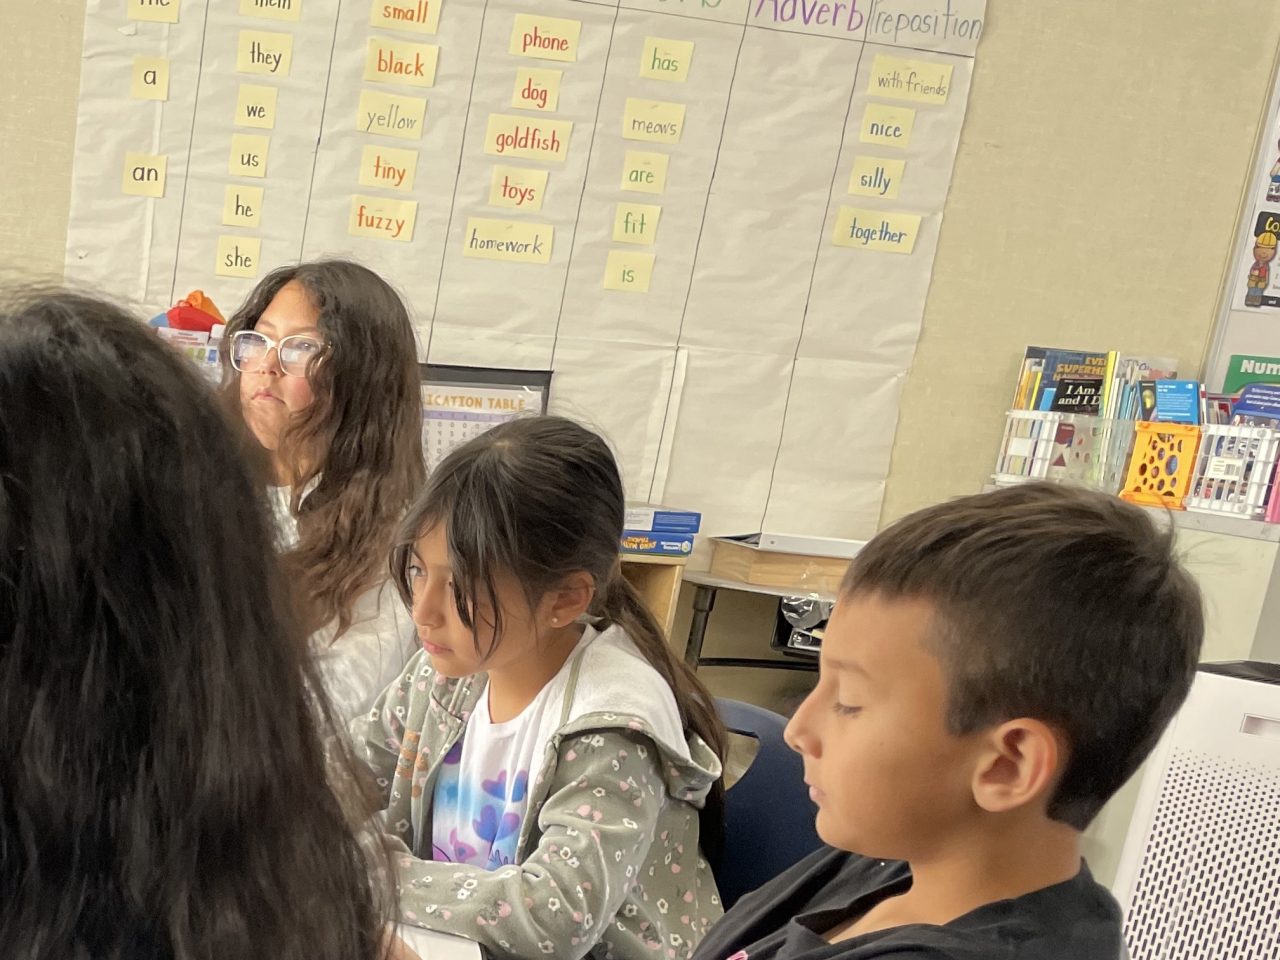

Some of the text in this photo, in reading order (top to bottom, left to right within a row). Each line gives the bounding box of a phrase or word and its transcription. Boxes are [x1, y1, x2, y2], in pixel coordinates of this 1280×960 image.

[383, 0, 429, 23] small
[522, 26, 569, 53] phone
[249, 41, 283, 72] they
[377, 49, 425, 77] black
[651, 47, 679, 72] has
[143, 69, 157, 86] a
[877, 70, 947, 96] with friends
[521, 78, 549, 109] dog
[246, 104, 266, 119] we
[366, 103, 418, 131] yellow
[631, 117, 678, 137] meows
[870, 121, 903, 139] nice
[495, 126, 560, 153] goldfish
[240, 152, 260, 169] us
[373, 156, 407, 186] tiny
[132, 166, 159, 183] an
[628, 168, 655, 185] are
[860, 166, 891, 195] silly
[501, 176, 536, 205] toys
[234, 194, 254, 218] he
[357, 206, 406, 237] fuzzy
[624, 212, 647, 236] fit
[849, 217, 907, 245] together
[469, 228, 543, 255] homework
[223, 246, 253, 269] she
[621, 264, 635, 284] is
[1058, 396, 1081, 405] and
[1090, 396, 1100, 405] D
[1074, 385, 1095, 395] Am
[487, 398, 526, 411] TABLE
